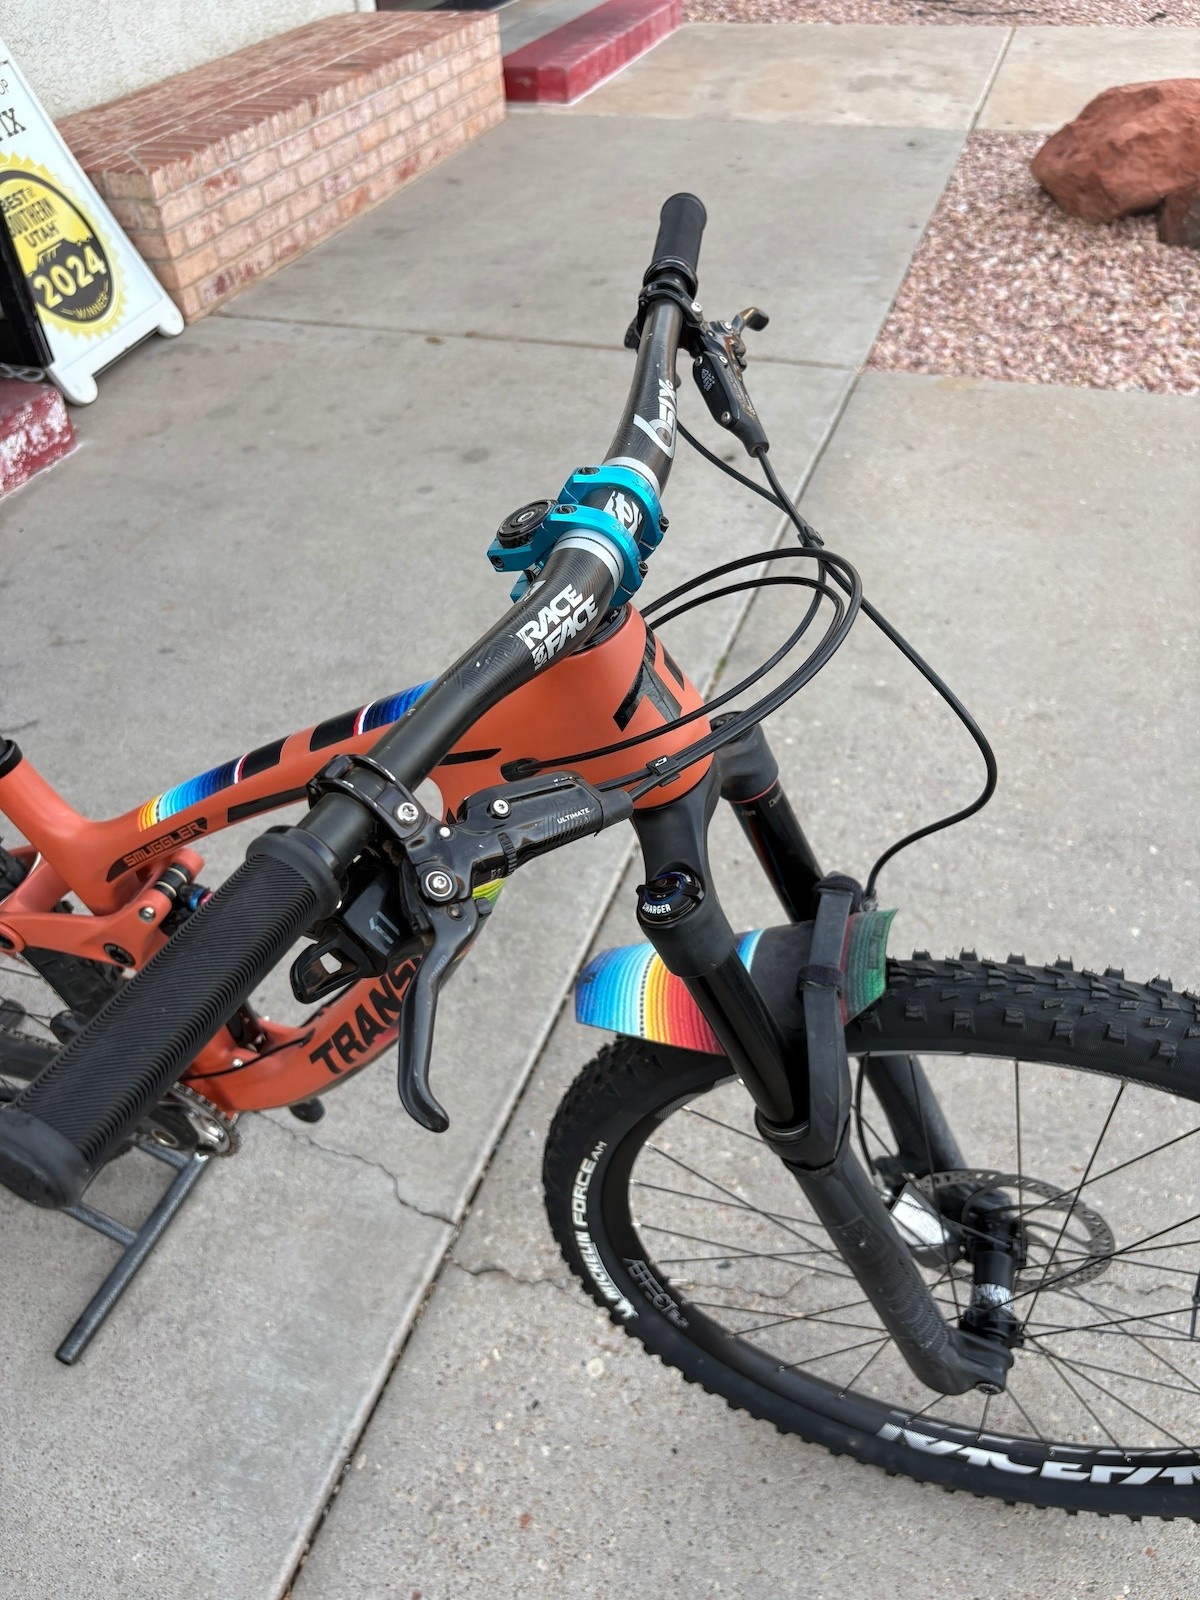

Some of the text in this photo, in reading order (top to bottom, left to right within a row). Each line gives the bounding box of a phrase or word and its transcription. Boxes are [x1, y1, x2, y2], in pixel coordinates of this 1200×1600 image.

[0, 108, 26, 141] IX
[24, 221, 60, 248] UTAH
[33, 246, 107, 309] 2024
[515, 583, 583, 650] RACE
[544, 593, 599, 660] FACE
[556, 807, 590, 824] ULTIMATE
[122, 821, 208, 867] SMUGGLER
[641, 901, 672, 915] CHARGER
[571, 1140, 623, 1301] MICHELIN FORCE AM
